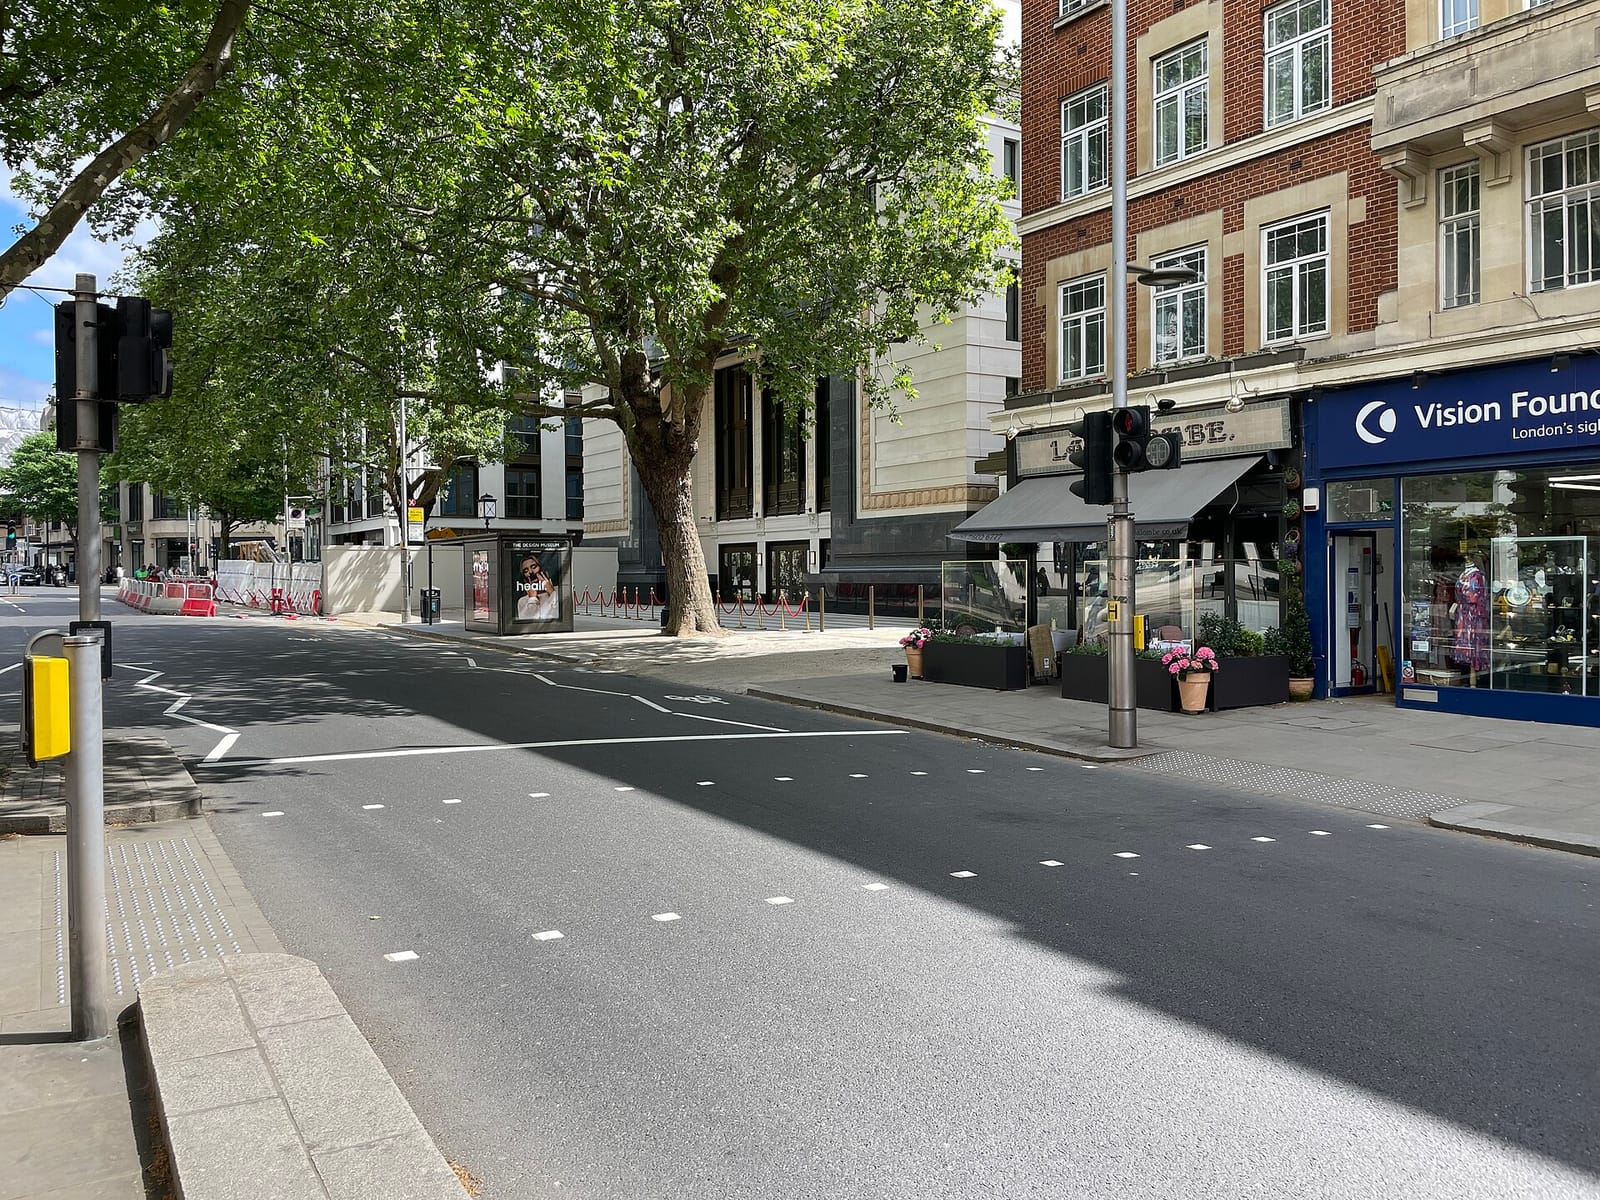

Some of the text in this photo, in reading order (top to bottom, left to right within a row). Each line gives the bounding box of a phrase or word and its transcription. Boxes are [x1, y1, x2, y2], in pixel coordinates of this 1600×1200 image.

[1414, 400, 1500, 429] Vision
[1512, 418, 1600, 440] London's sig
